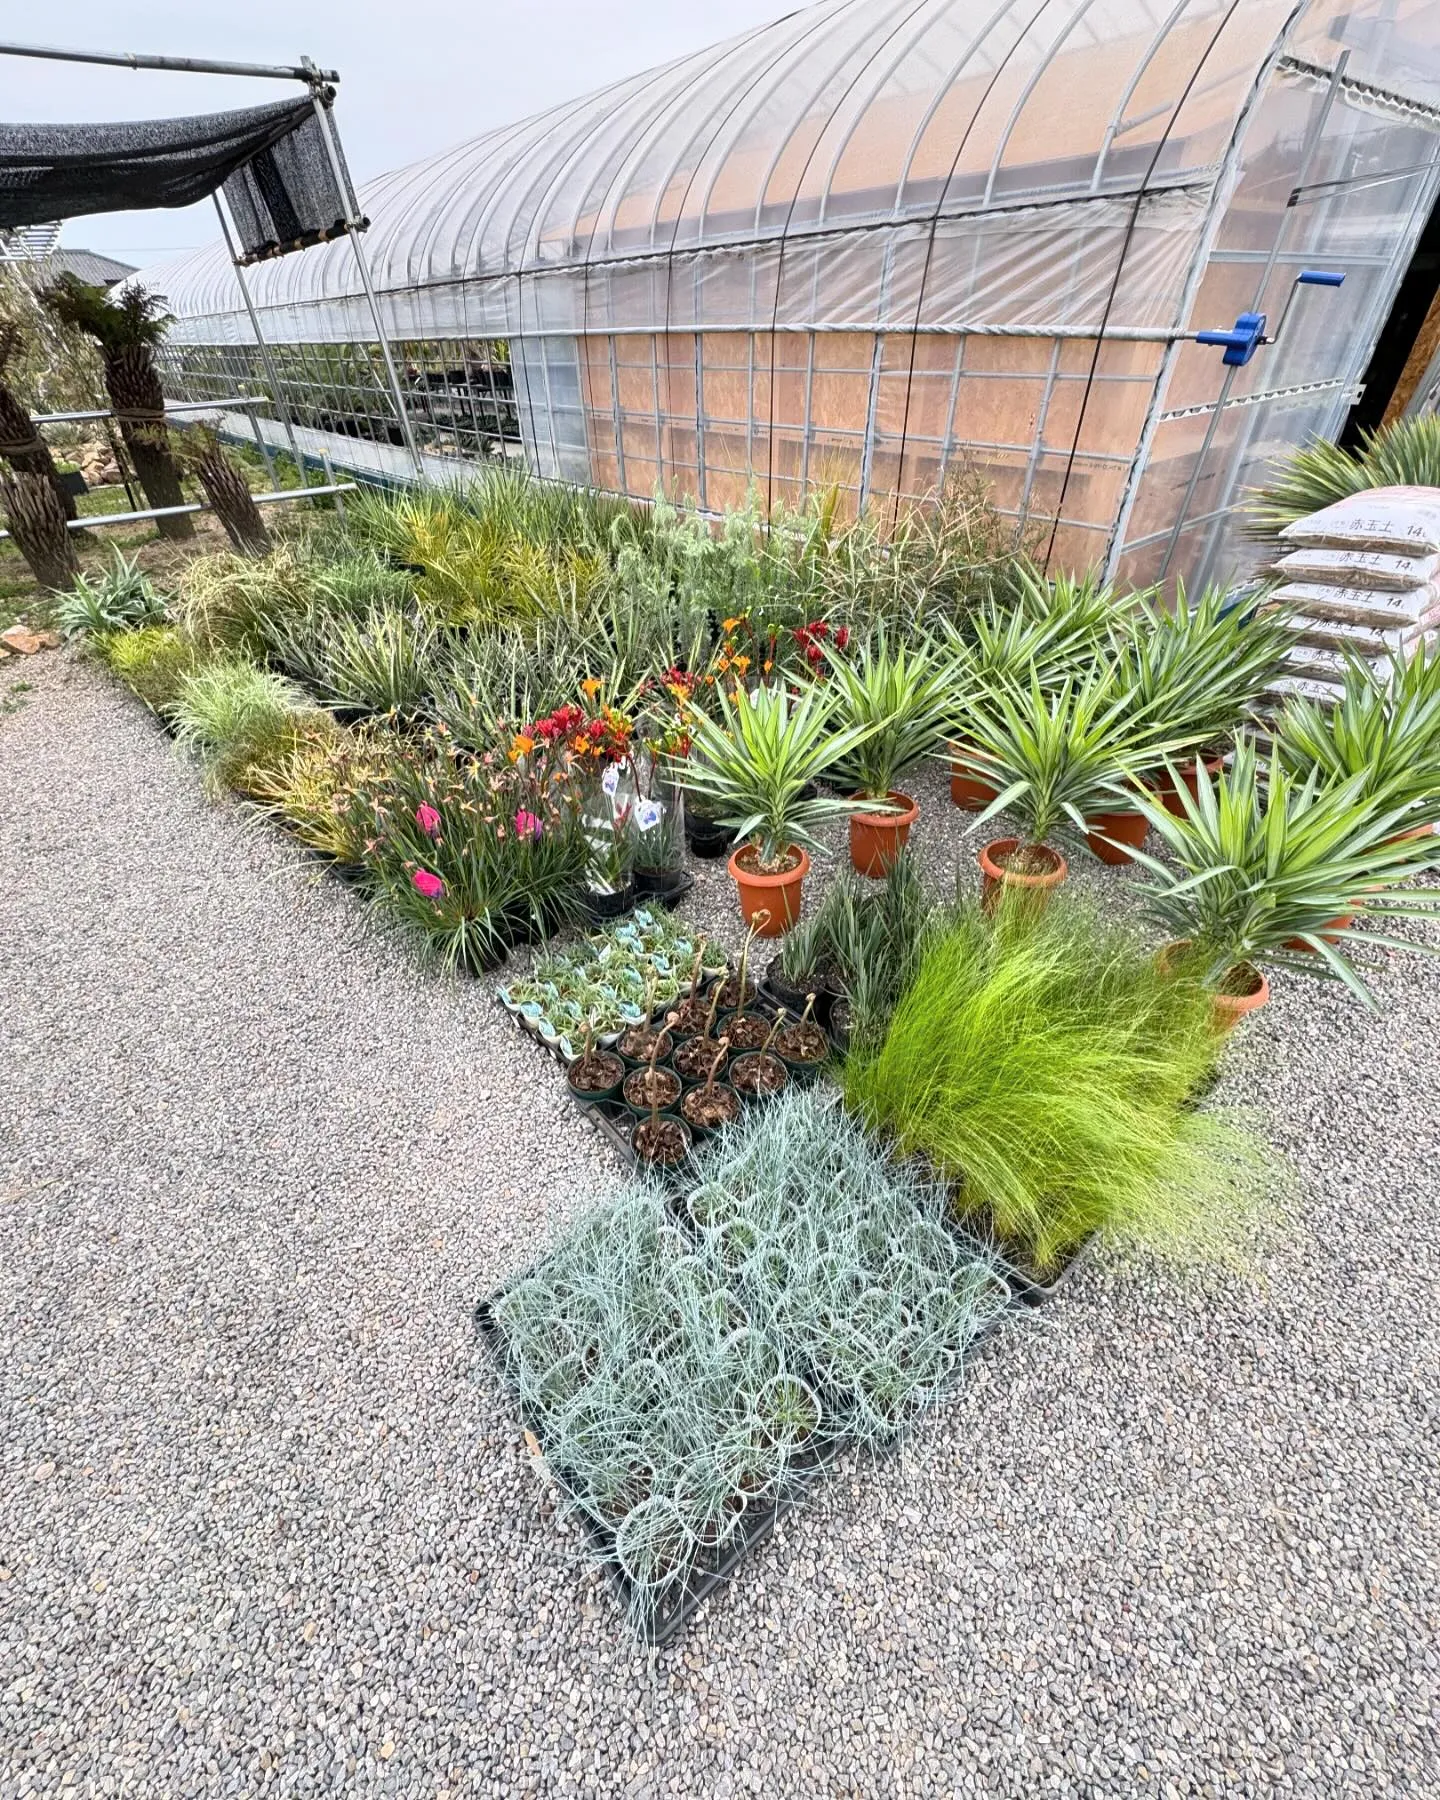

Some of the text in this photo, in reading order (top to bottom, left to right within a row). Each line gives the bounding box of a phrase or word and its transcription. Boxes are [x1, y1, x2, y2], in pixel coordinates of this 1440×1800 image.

[1349, 519, 1393, 533] 赤玉土
[1340, 552, 1383, 565] 赤玉土
[1333, 588, 1375, 603] 赤玉土
